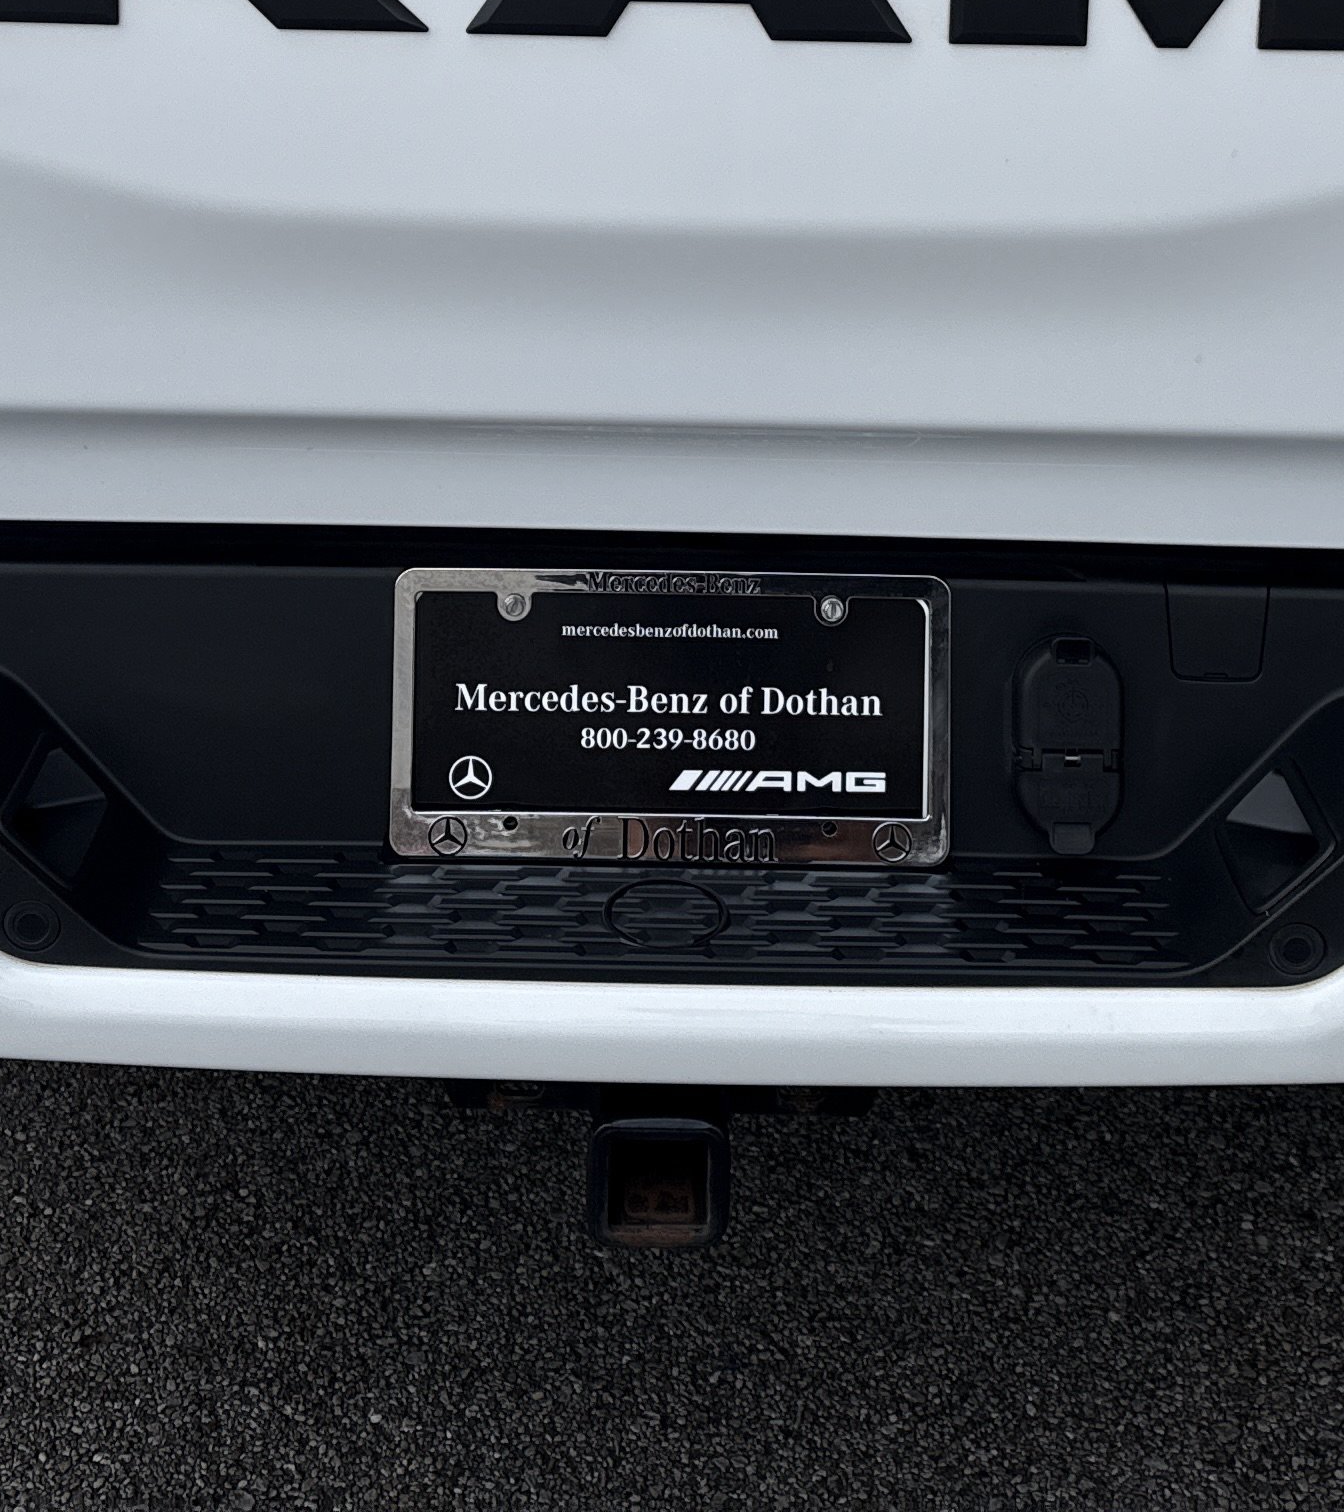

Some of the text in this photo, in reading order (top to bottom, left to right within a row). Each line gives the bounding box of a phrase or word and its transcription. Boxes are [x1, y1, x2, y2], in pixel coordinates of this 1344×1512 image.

[586, 571, 762, 595] Mercedes-Benz
[561, 622, 779, 640] mercedesbenzofdothan.com
[455, 683, 883, 717] Mercedes-Benz of Dothan
[579, 727, 757, 752] 800-239-8680
[746, 769, 887, 793] AMG
[561, 815, 779, 862] of Dothan
